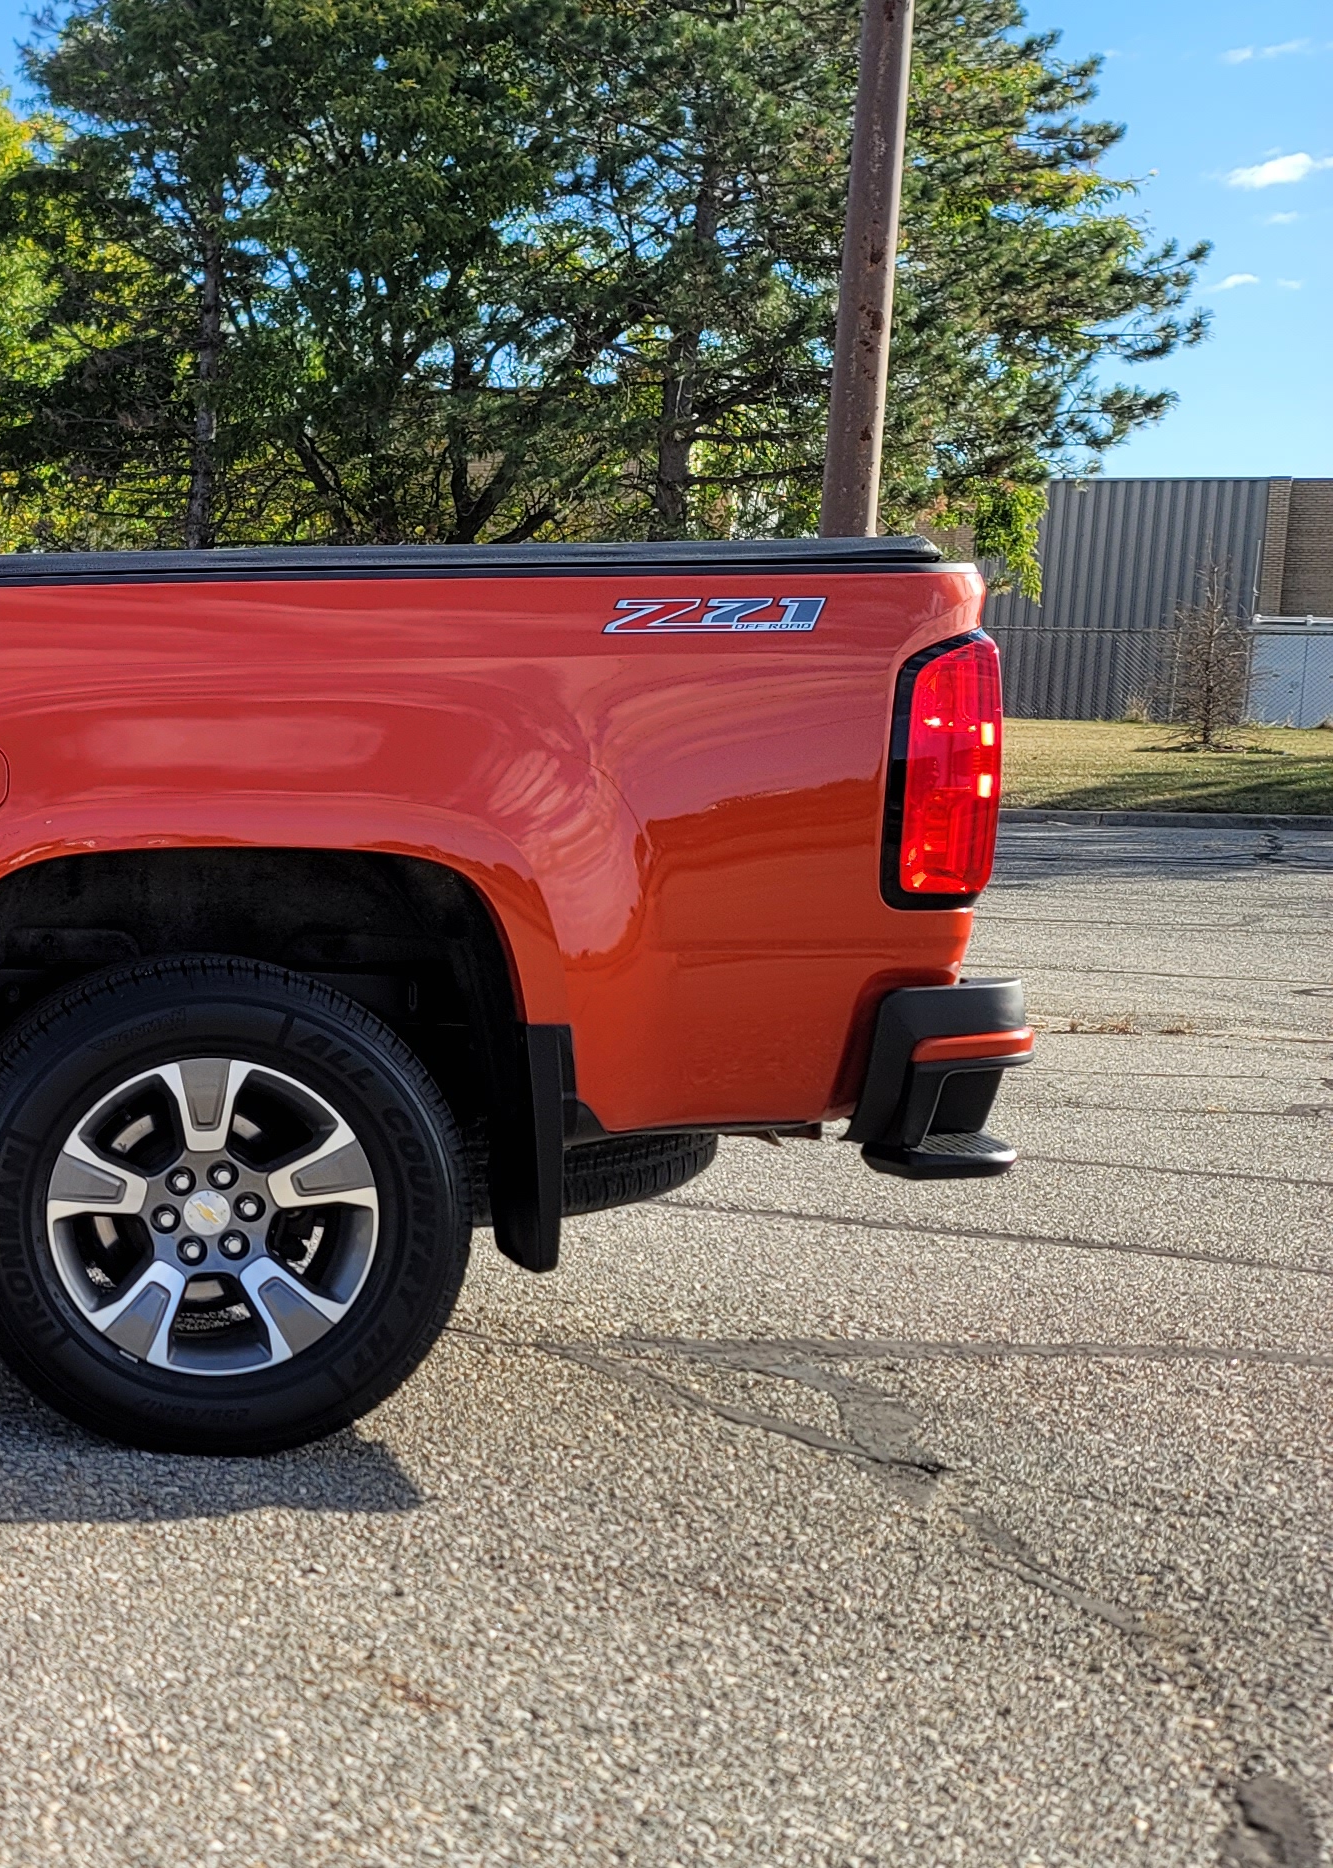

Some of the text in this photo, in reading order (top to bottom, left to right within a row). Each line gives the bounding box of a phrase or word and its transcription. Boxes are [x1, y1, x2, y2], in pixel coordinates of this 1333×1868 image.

[602, 597, 826, 634] Z71
[768, 622, 812, 630] ROAD
[295, 1032, 375, 1092] ALL
